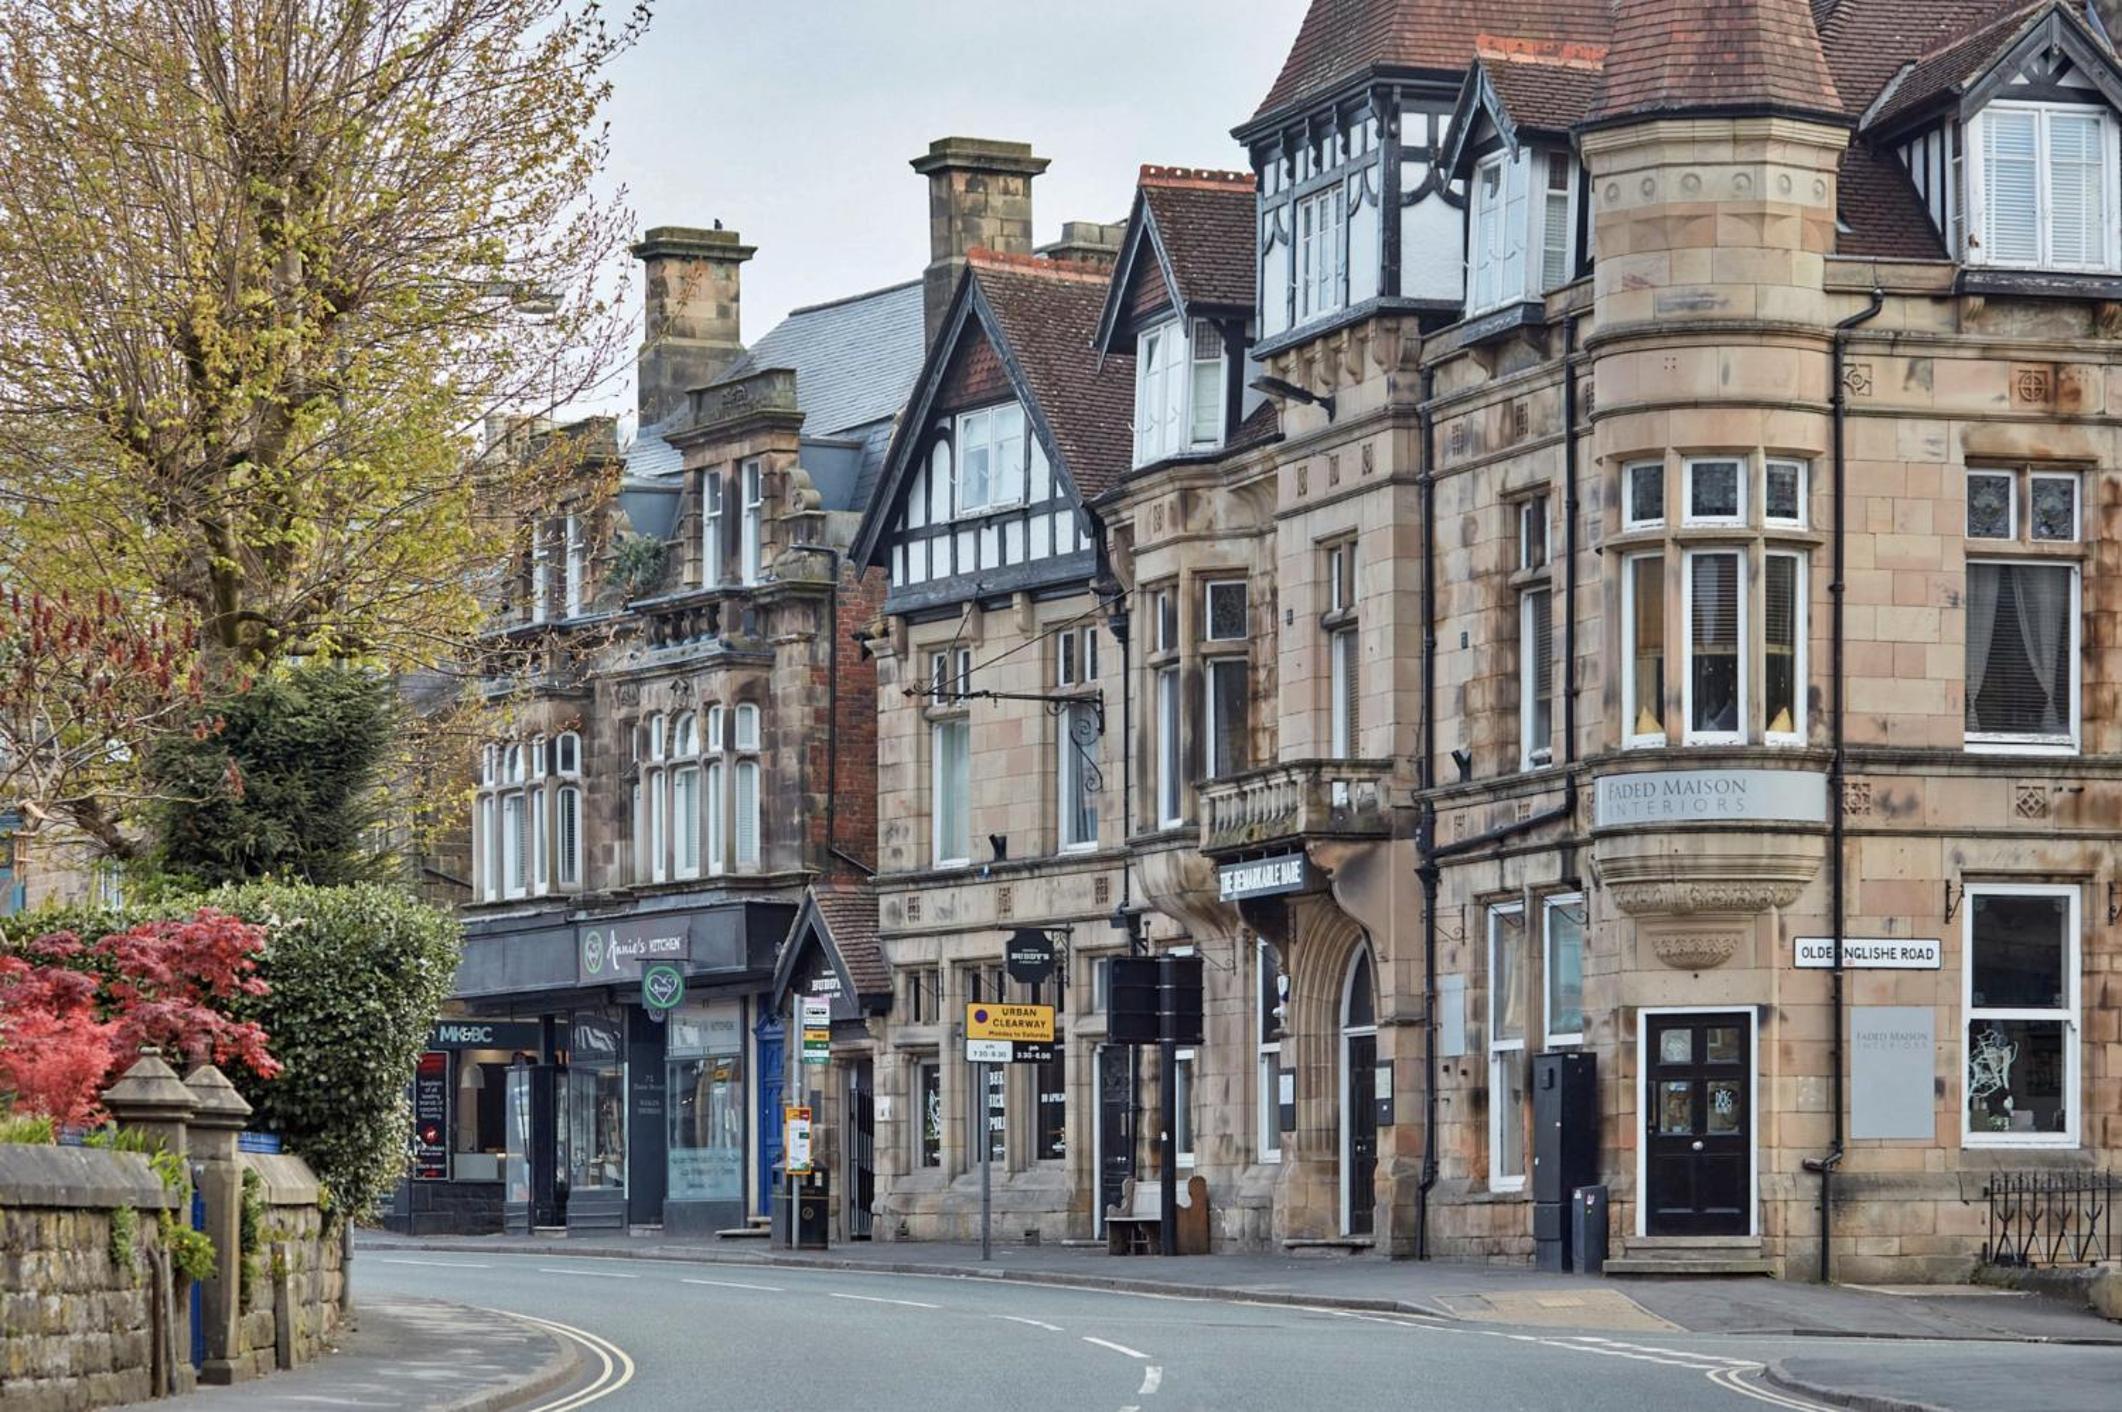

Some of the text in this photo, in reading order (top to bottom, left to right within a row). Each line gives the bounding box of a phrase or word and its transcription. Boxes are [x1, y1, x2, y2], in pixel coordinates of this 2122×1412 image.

[1609, 778, 1747, 800] FADED MAISON
[1608, 797, 1745, 816] INTERIORS
[606, 929, 646, 970] Annie's
[649, 936, 681, 953] KITCHEN
[1801, 946, 1935, 960] OLDE NGLISHE ROAD
[1002, 1008, 1037, 1016] URBAN
[992, 1018, 1046, 1028] CLEARWAY
